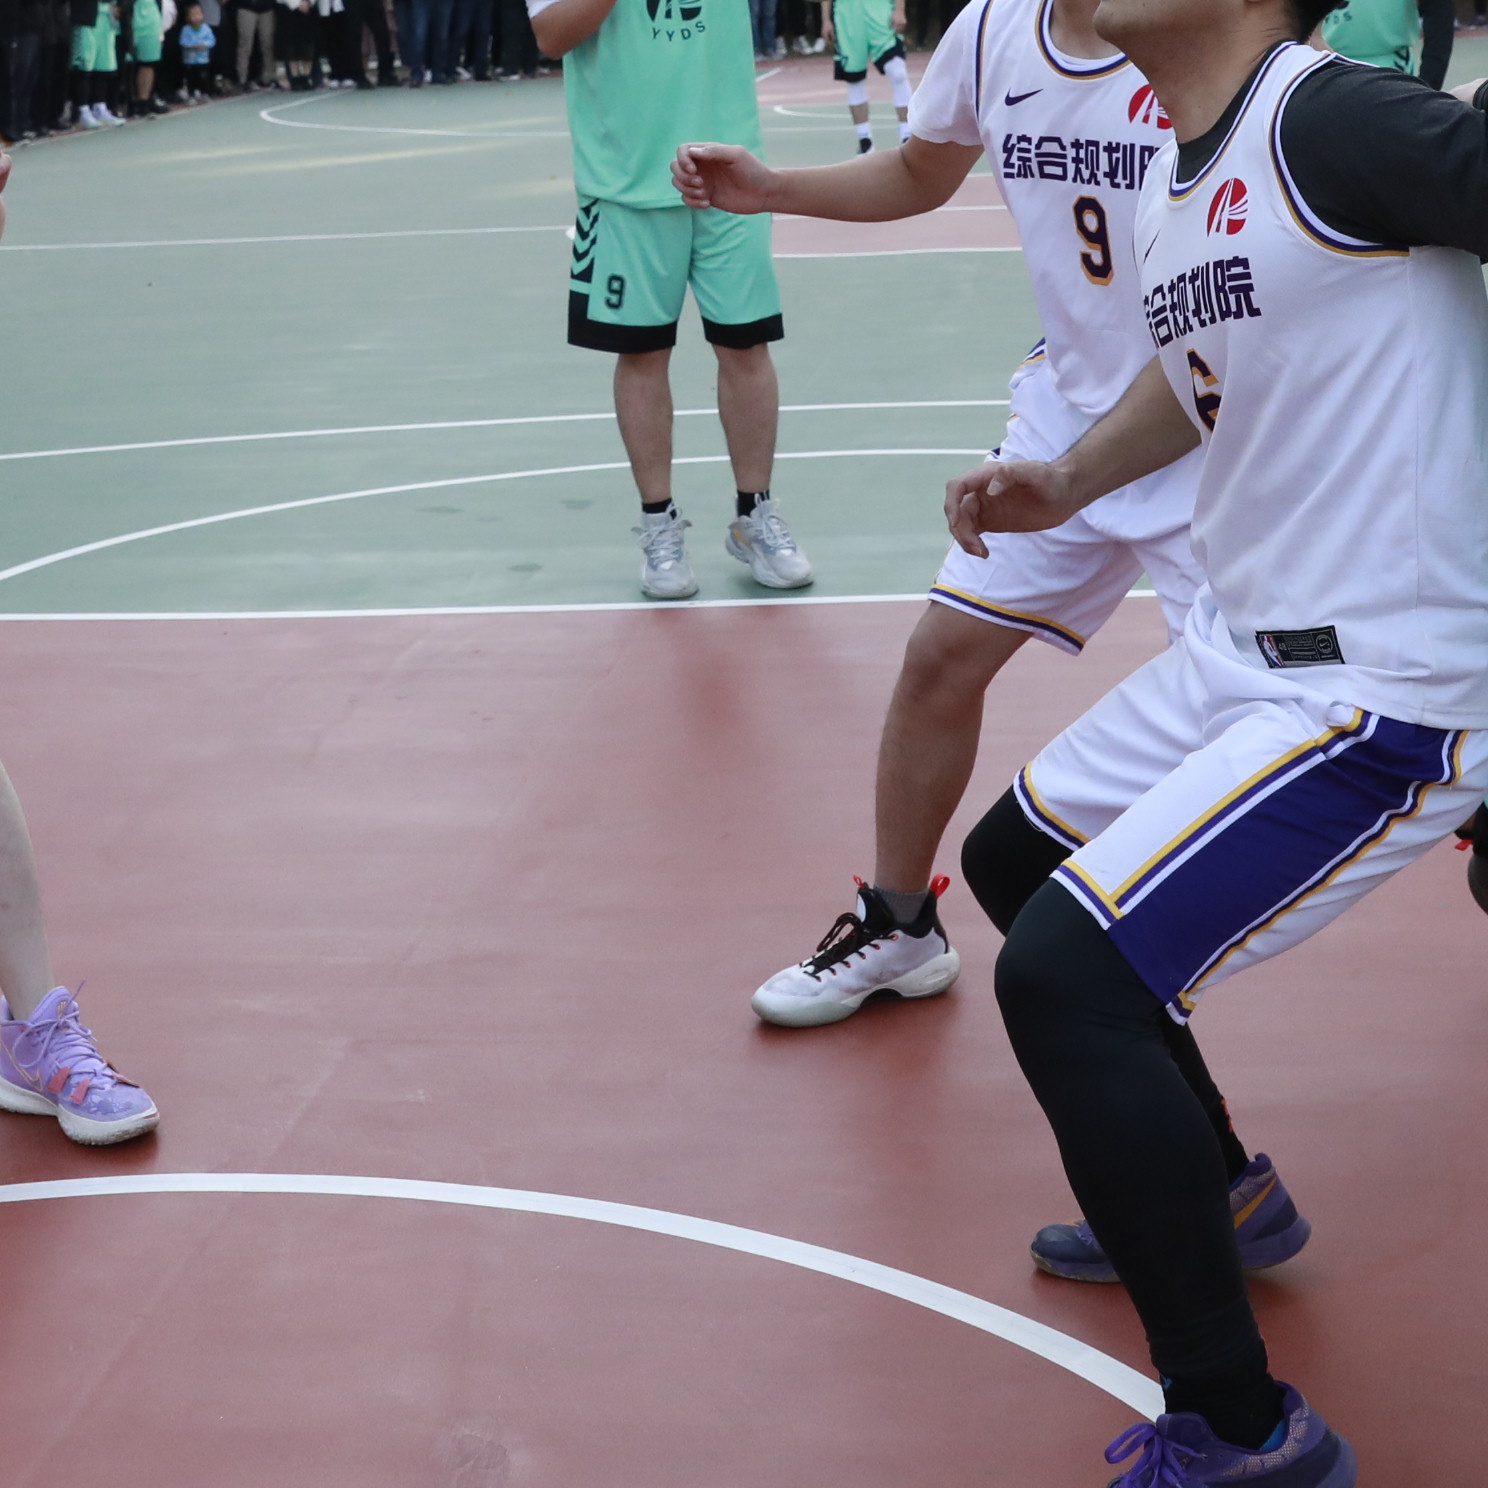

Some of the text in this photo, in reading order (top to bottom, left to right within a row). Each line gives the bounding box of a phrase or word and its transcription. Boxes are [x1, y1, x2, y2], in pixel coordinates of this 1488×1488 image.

[652, 21, 706, 42] YYDS
[1073, 195, 1114, 287] 9
[605, 274, 627, 311] 9
[1143, 255, 1262, 349] 合规划院
